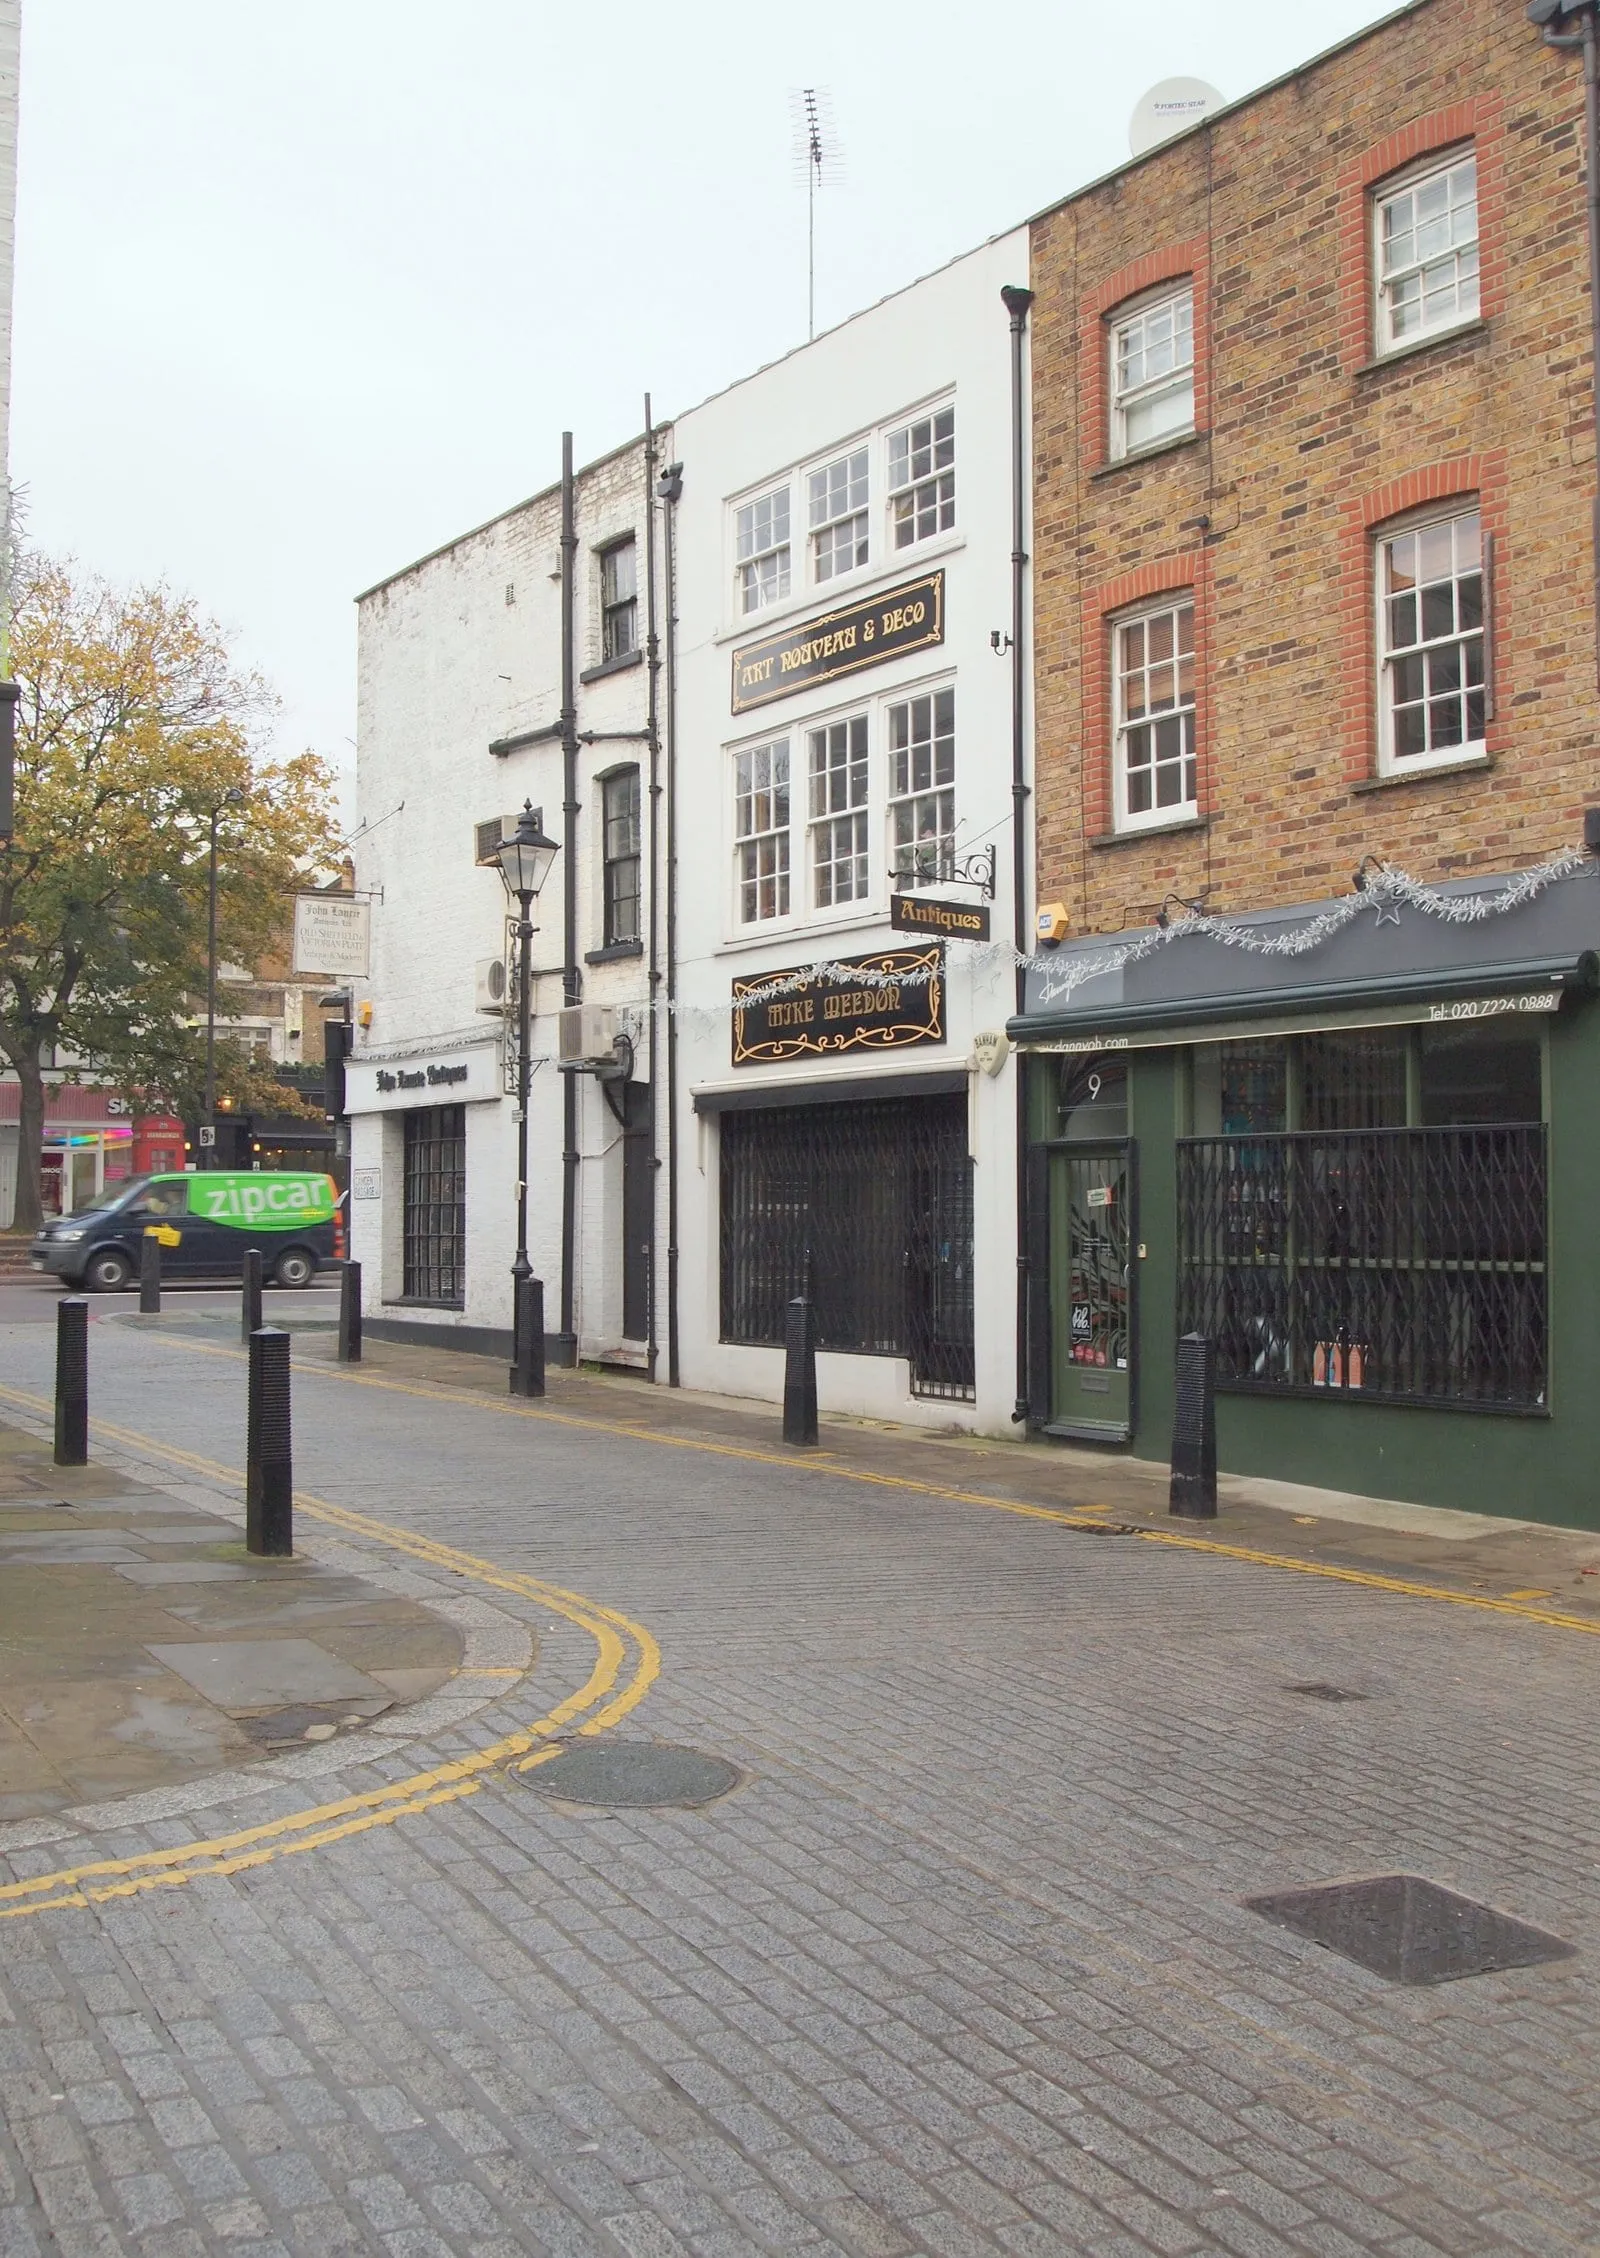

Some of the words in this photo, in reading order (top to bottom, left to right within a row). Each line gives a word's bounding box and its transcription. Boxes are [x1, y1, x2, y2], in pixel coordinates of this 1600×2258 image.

[742, 656, 775, 687] ART
[780, 625, 858, 673] NOUVEAU
[863, 619, 875, 642] &
[882, 601, 926, 636] DECO
[304, 903, 329, 916] John
[901, 900, 982, 931] Antiques
[768, 999, 815, 1028] MIKE
[823, 986, 902, 1021] WEEDON
[1428, 1003, 1449, 1020] Tel:
[1451, 1002, 1478, 1019] 020
[1519, 994, 1554, 1010] 0888
[1088, 1074, 1101, 1100] 9
[203, 1179, 328, 1223] zipcar
